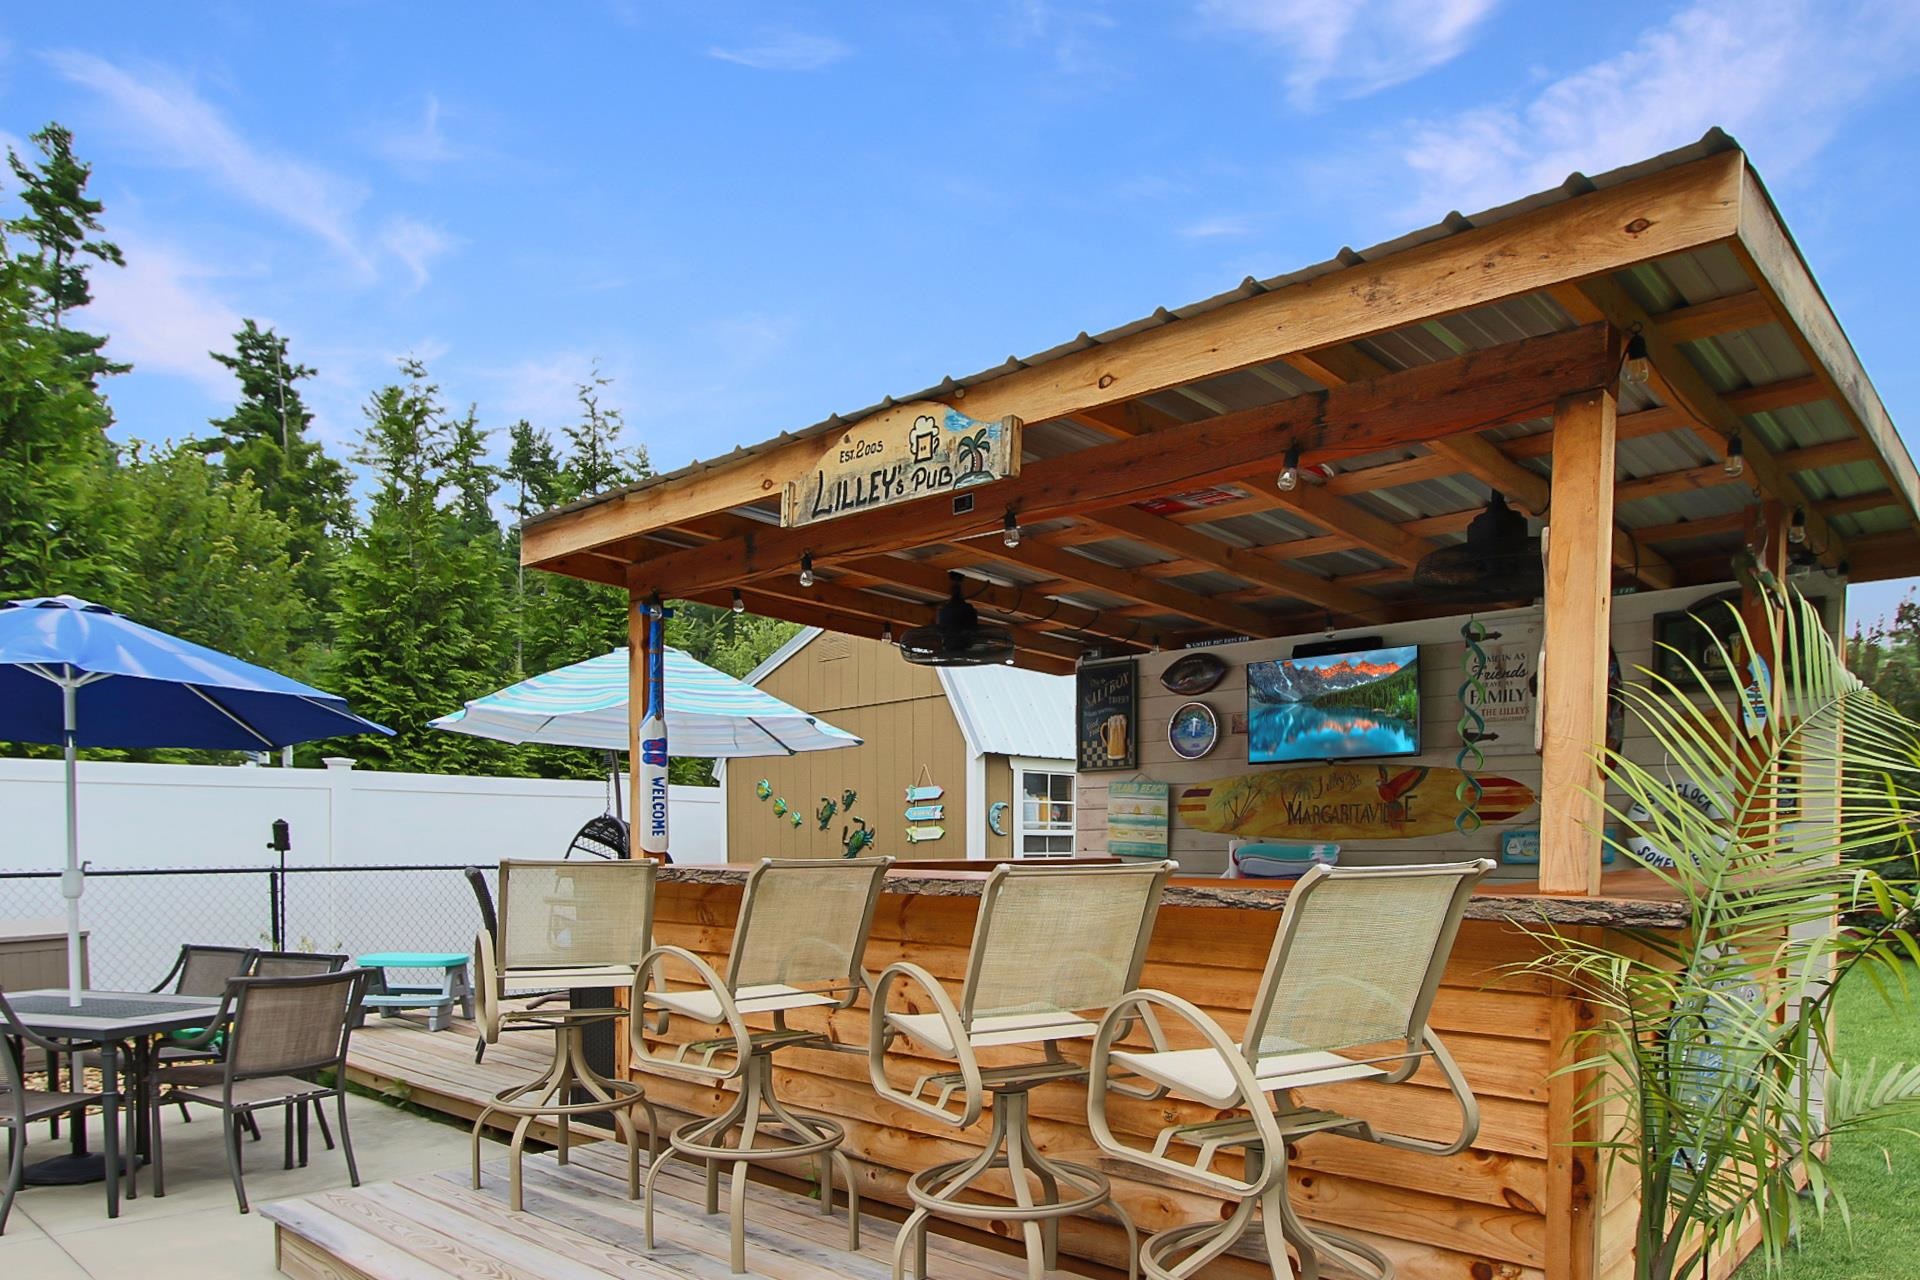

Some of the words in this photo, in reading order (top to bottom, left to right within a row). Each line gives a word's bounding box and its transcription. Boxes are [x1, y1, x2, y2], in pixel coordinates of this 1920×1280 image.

[855, 440, 884, 460] 2005
[911, 466, 954, 492] PUB
[1473, 654, 1499, 664] CME
[1514, 652, 1526, 662] AS
[1470, 687, 1527, 705] FAMILY
[651, 776, 666, 837] WELCOME
